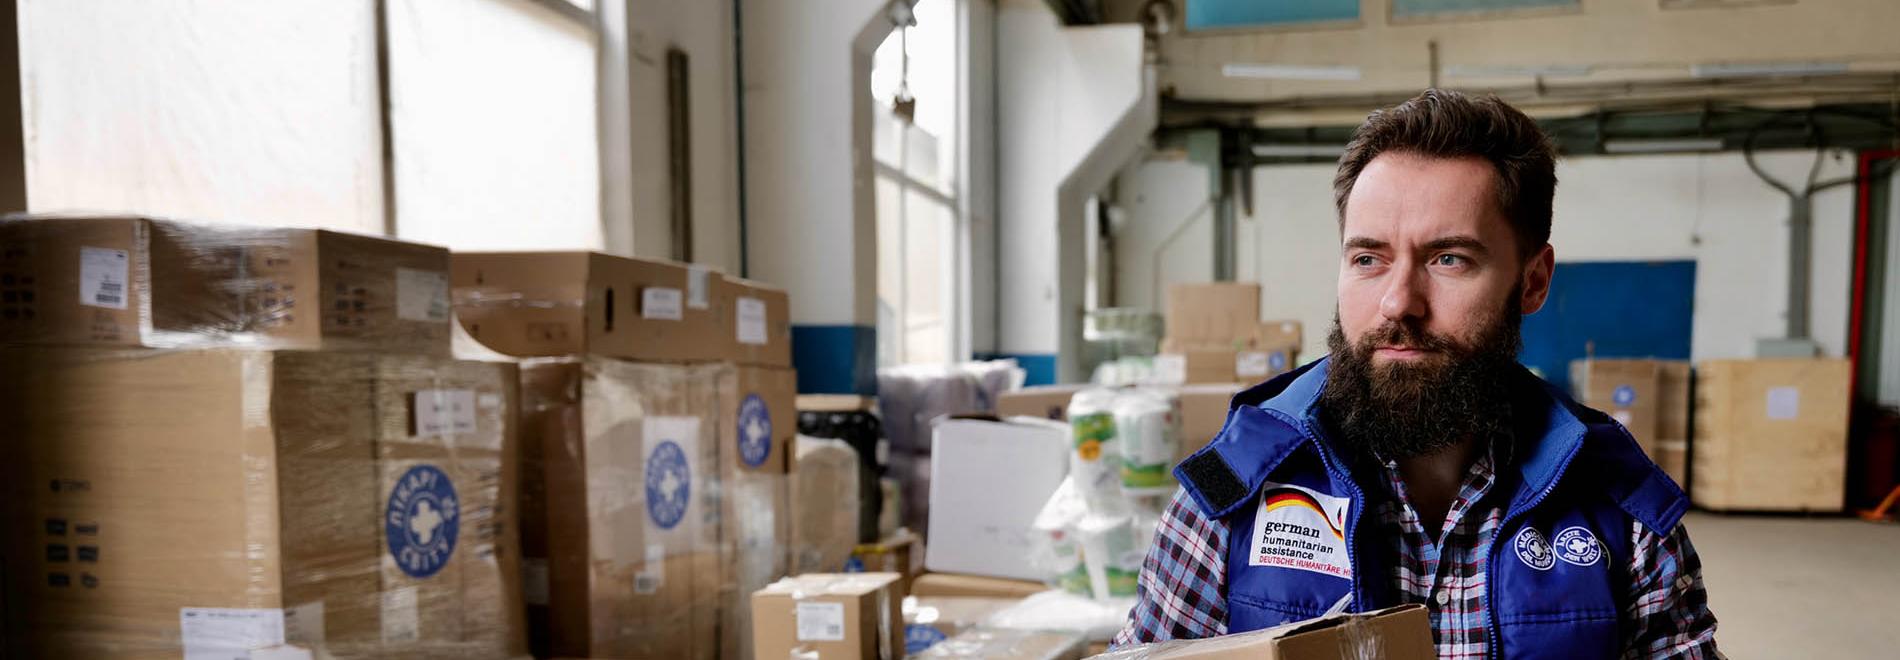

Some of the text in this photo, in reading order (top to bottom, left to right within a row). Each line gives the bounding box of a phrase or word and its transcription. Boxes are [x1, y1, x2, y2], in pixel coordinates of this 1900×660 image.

[1264, 521, 1320, 538] german
[1260, 546, 1314, 559] assistance
[1262, 535, 1333, 554] humanitarian
[1259, 555, 1294, 566] DEUTSCHE
[1296, 560, 1341, 575] HUMANITÄRE
